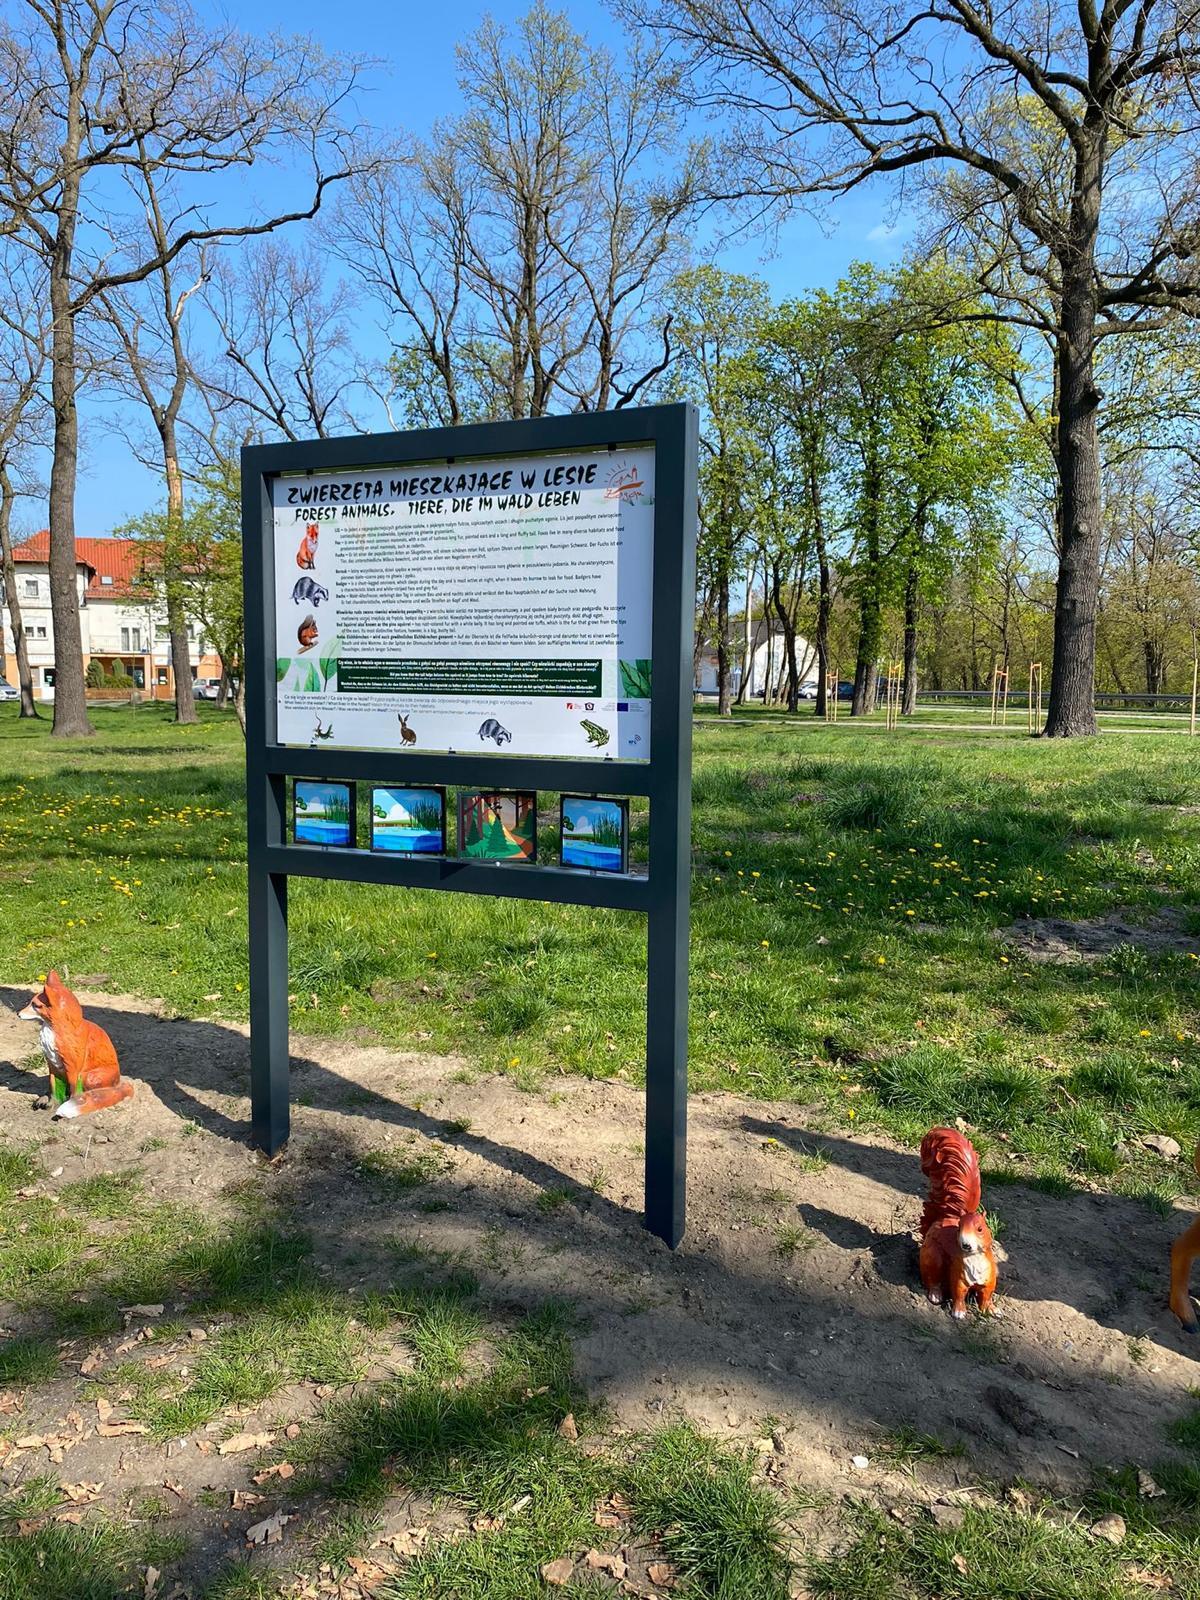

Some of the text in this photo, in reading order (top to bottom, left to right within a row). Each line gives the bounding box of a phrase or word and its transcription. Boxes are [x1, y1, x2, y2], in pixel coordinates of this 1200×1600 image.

[288, 464, 597, 504] ZWIERZĘTA MIESZKAJĄCE W LESIE
[296, 507, 336, 520] FOREST
[409, 500, 446, 514] TIERE,
[453, 498, 473, 512] DIE
[479, 497, 492, 510] IM
[498, 493, 532, 510] WALD
[539, 491, 580, 507] LEBEN
